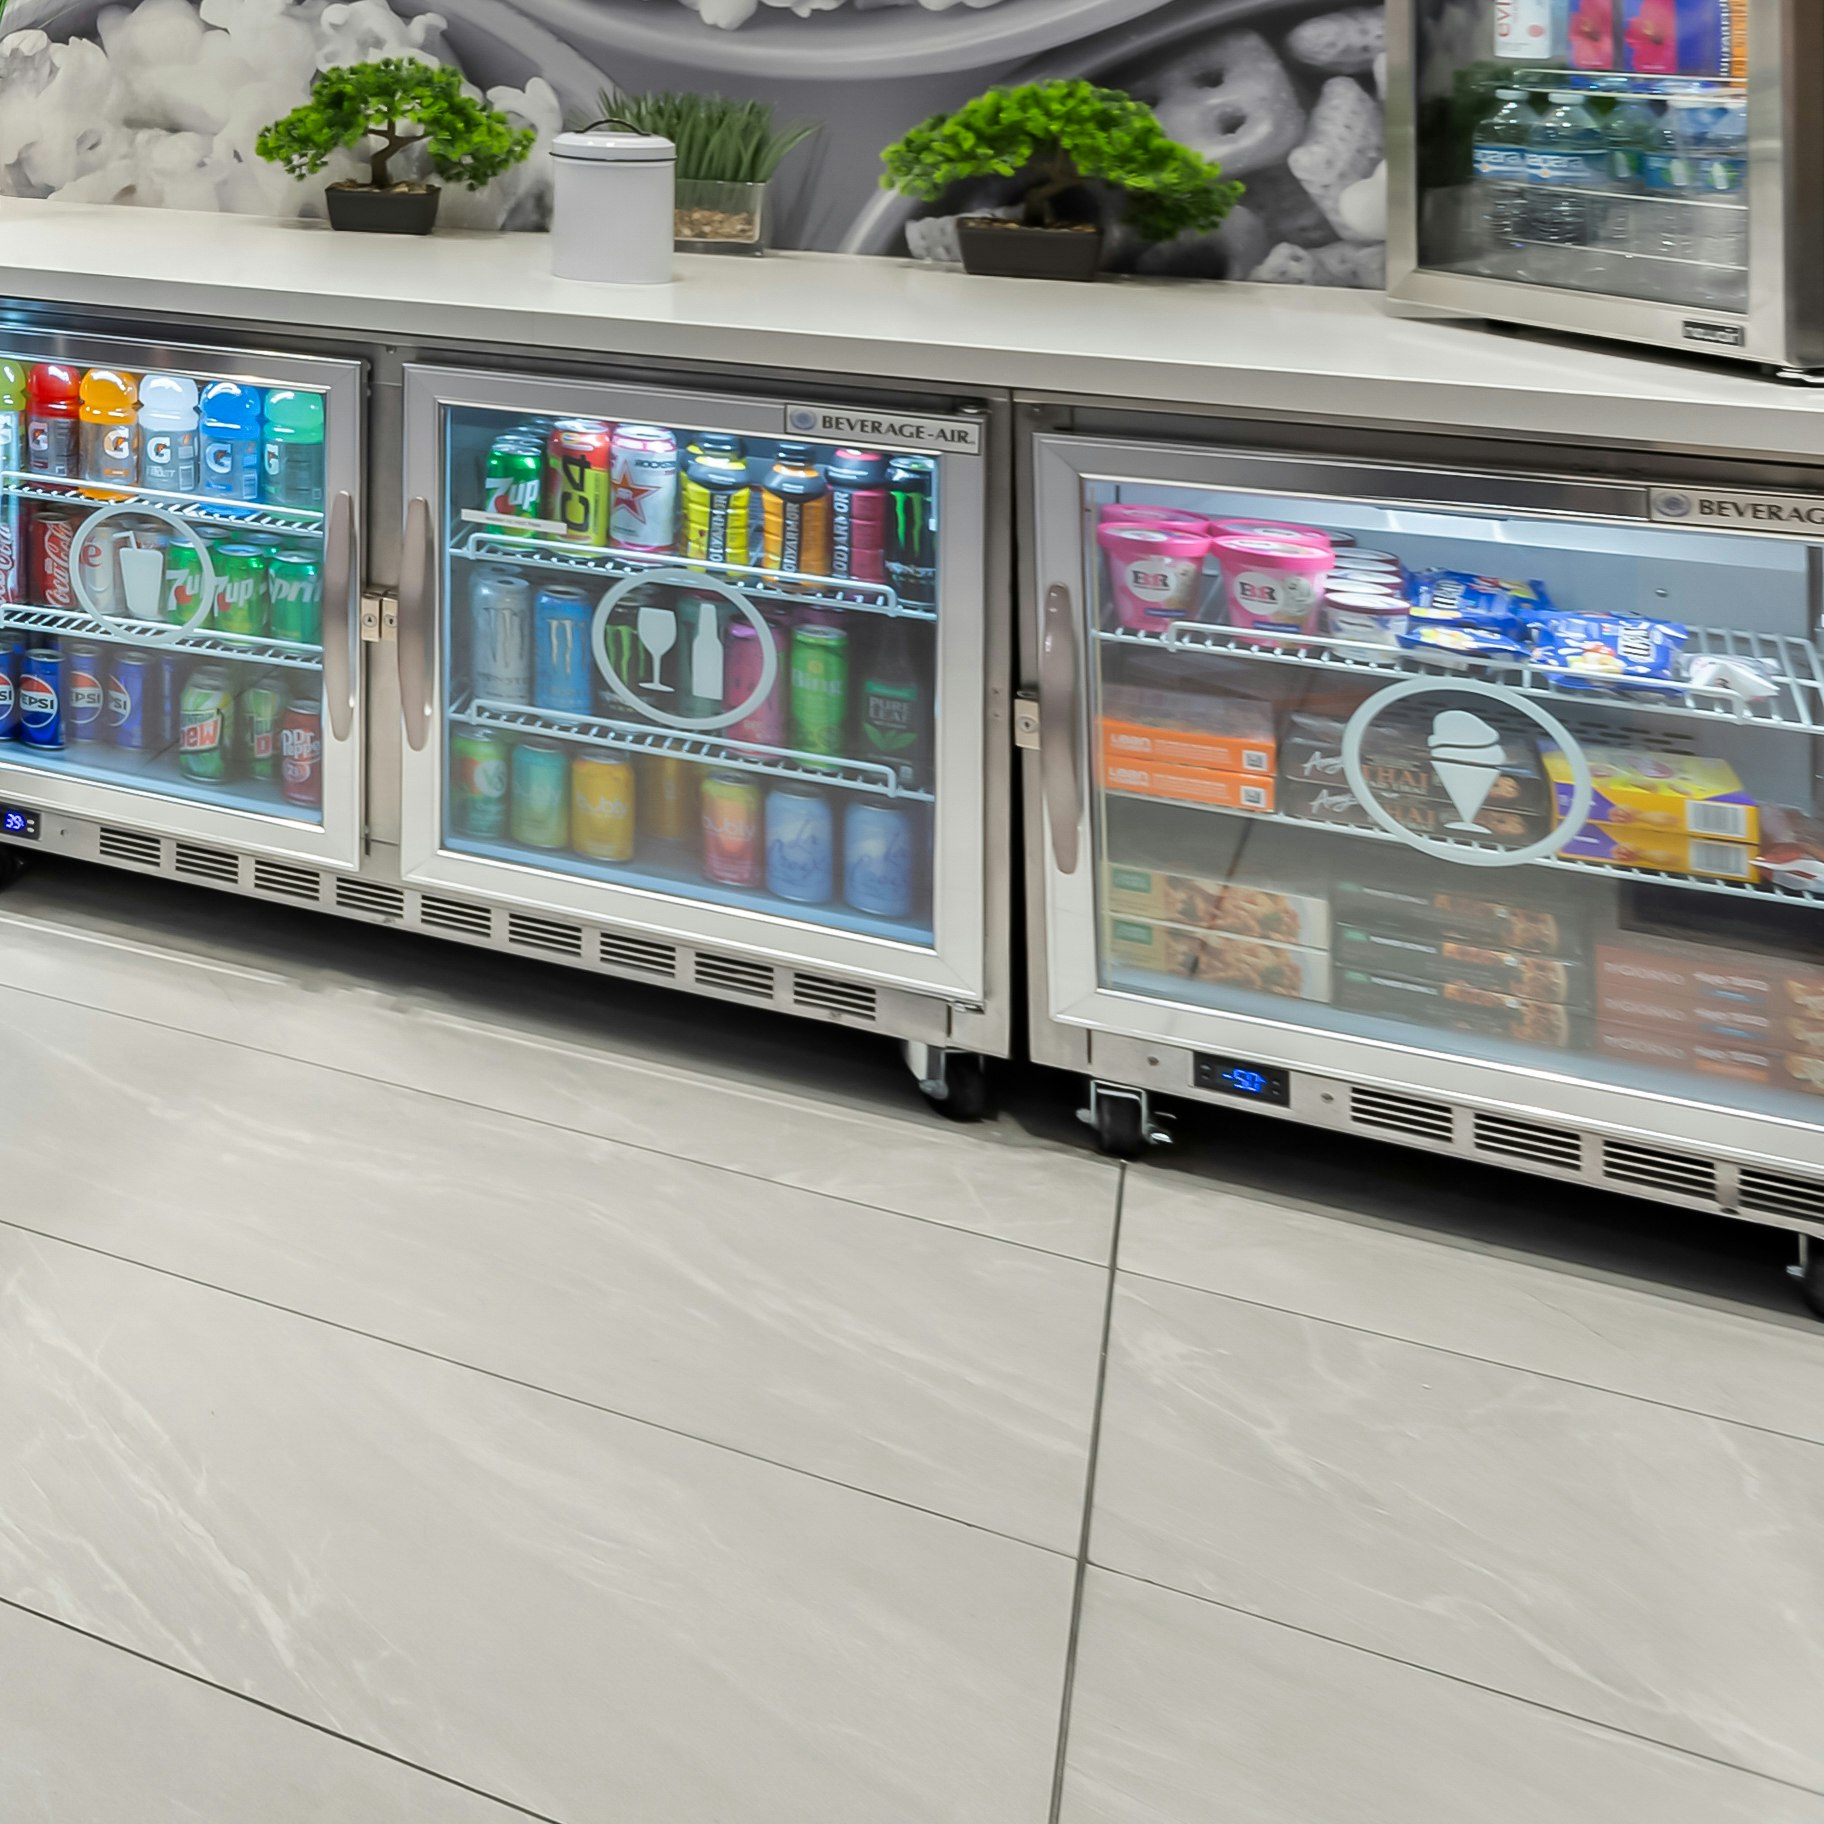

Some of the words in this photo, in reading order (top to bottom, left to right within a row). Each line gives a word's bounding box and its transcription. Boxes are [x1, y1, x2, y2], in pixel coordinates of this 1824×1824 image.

[821, 415, 972, 446] BEVERAGE-AIR
[487, 476, 539, 514] 7up
[569, 452, 593, 533] C4
